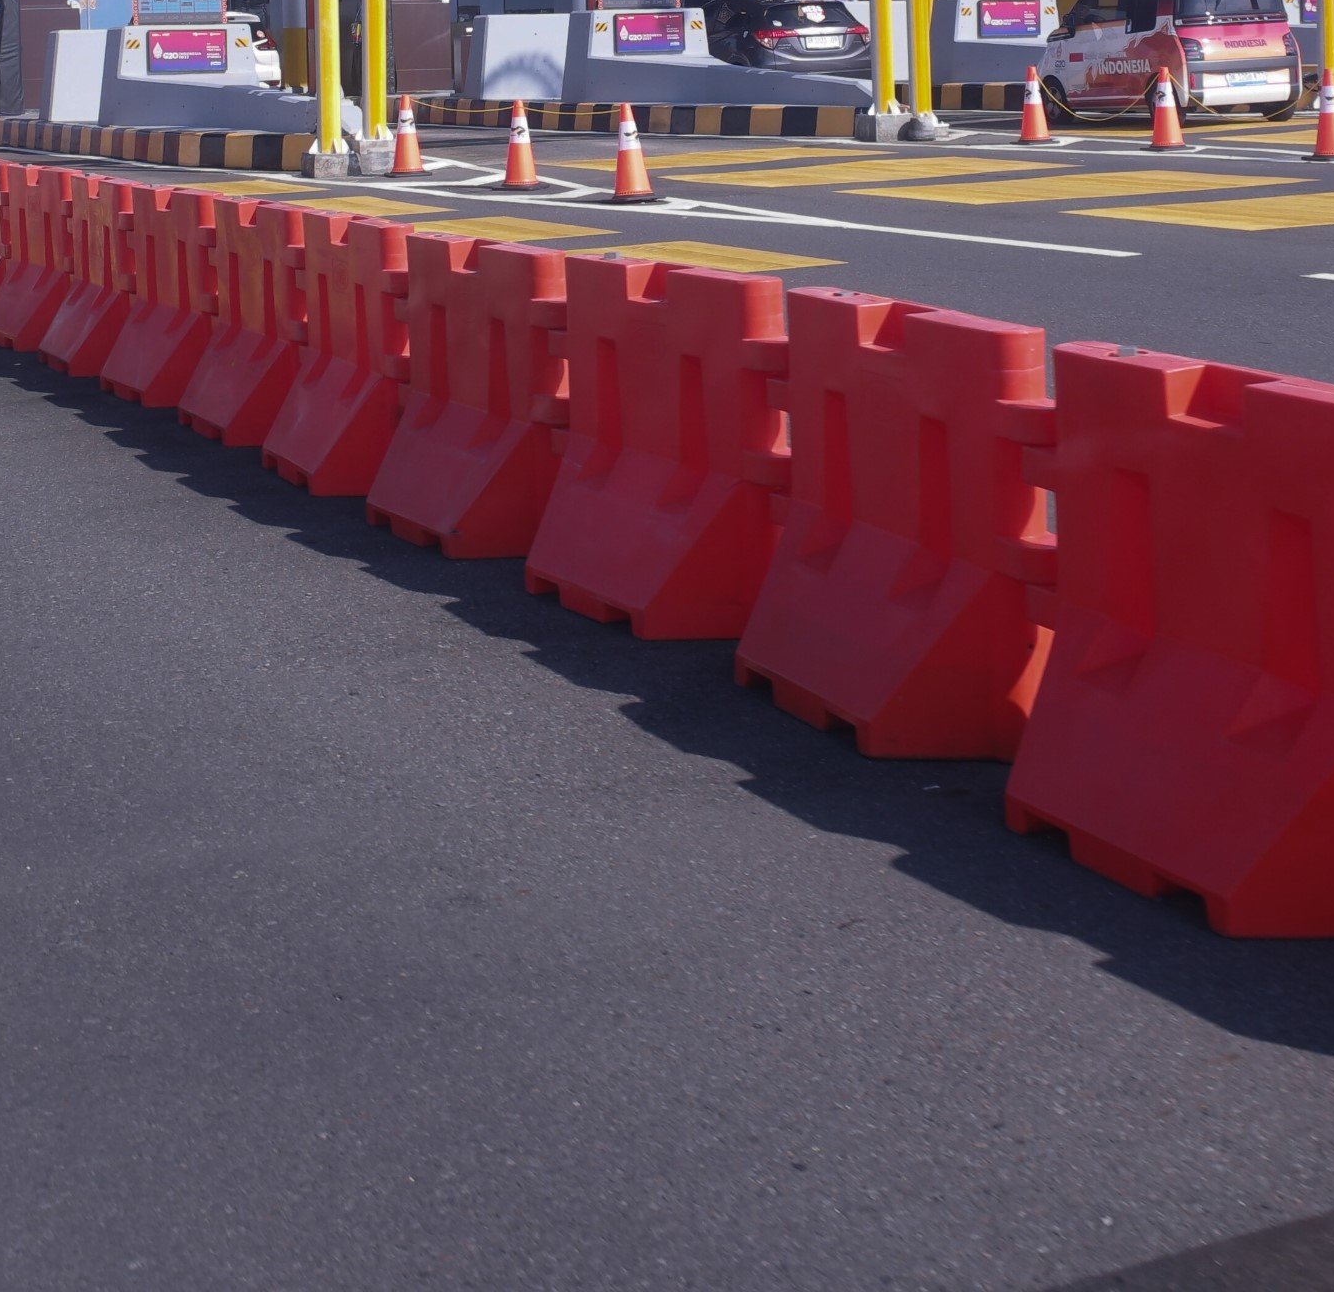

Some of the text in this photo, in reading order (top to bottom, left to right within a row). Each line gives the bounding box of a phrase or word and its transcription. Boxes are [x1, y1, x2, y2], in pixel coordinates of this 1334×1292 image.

[1224, 39, 1267, 49] INDONESIA
[162, 52, 178, 60] G20
[1098, 59, 1152, 75] INDONESIA
